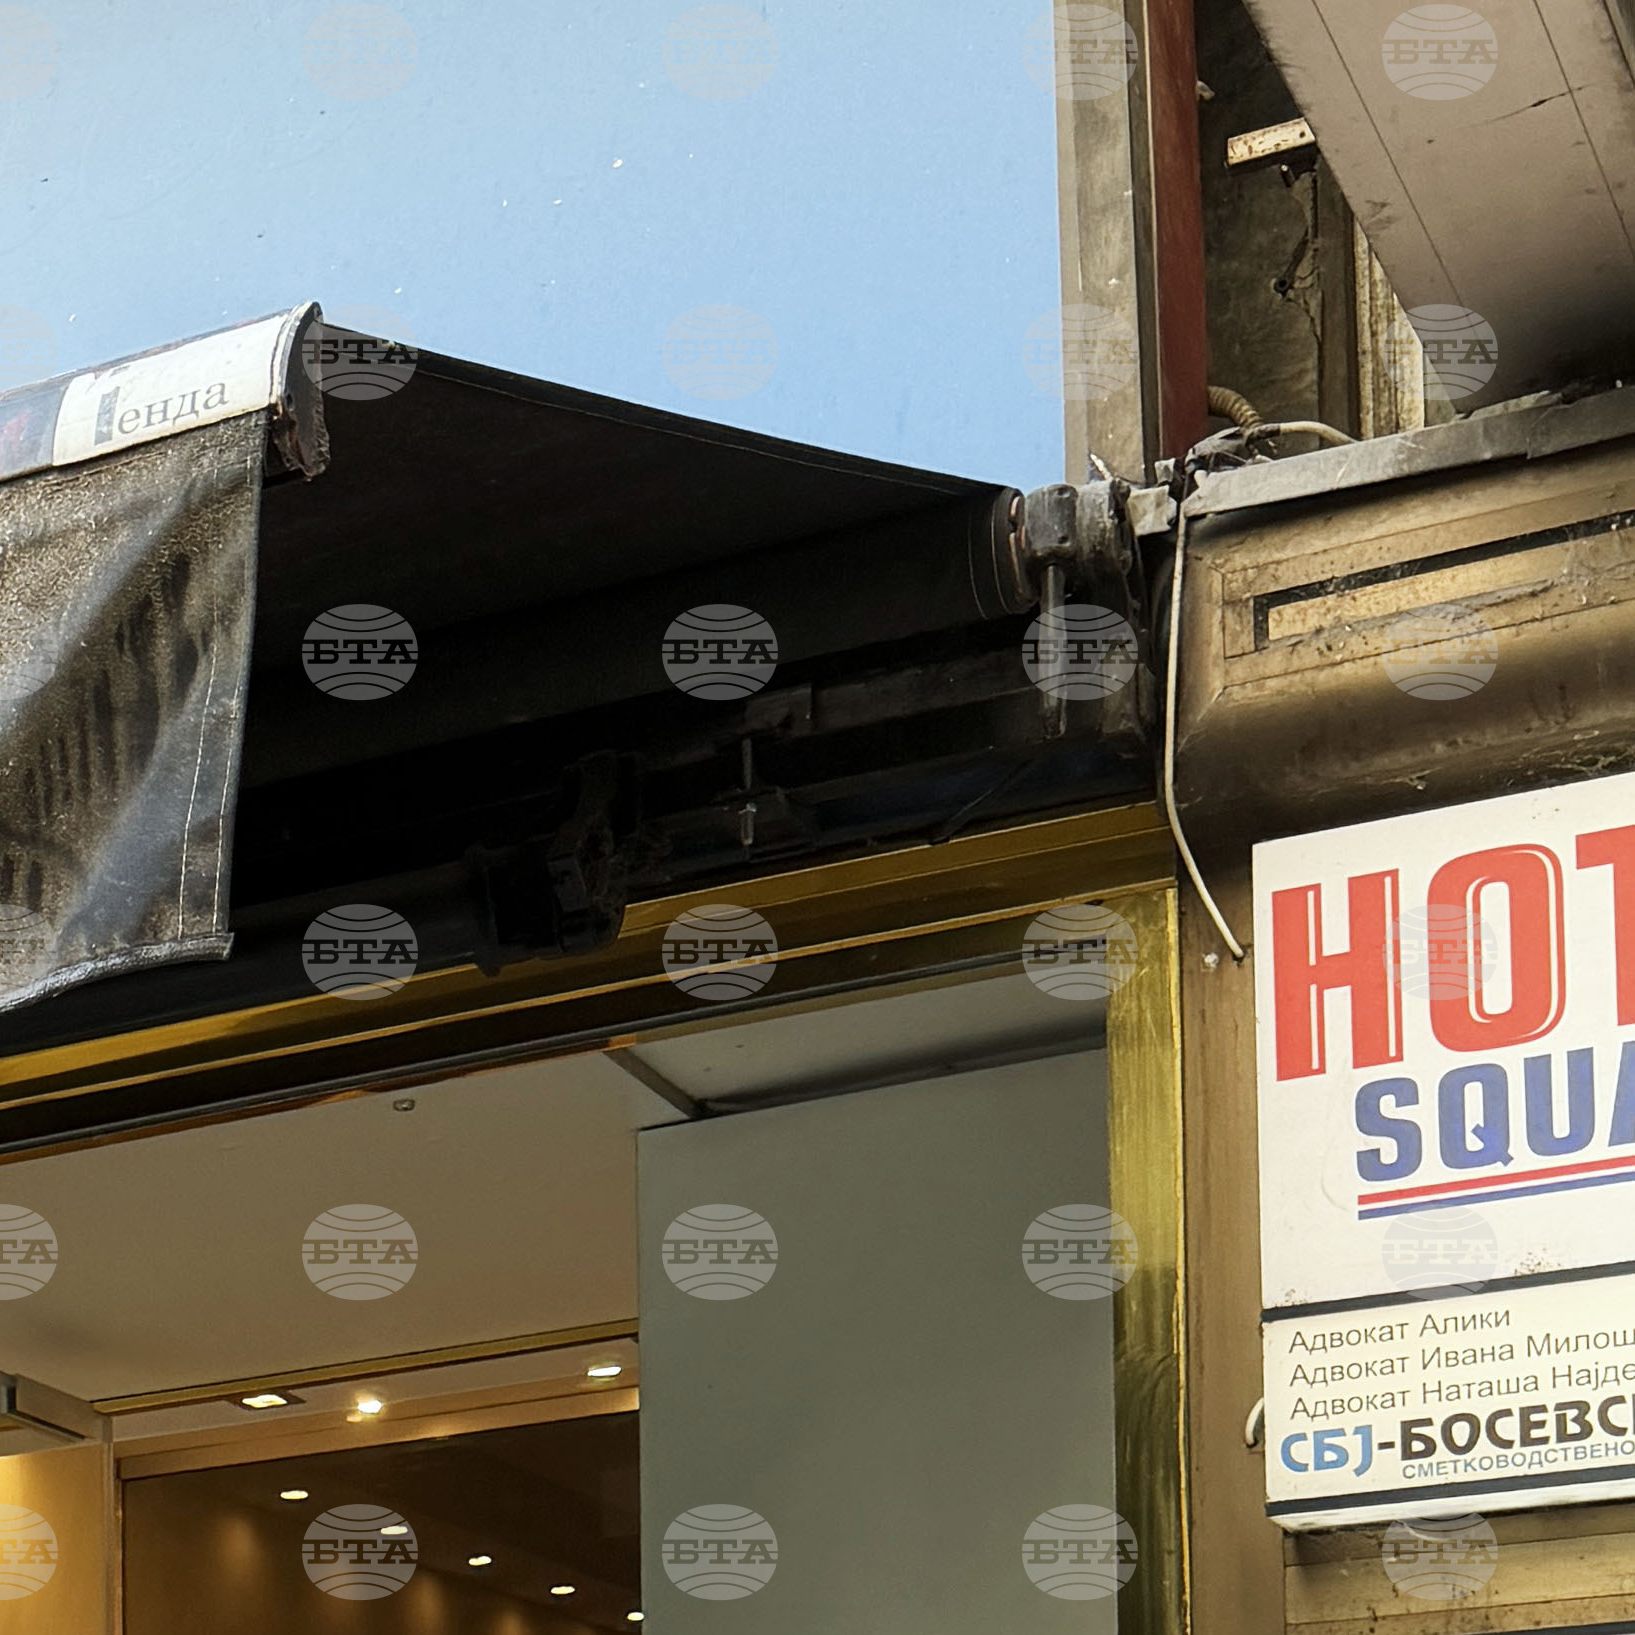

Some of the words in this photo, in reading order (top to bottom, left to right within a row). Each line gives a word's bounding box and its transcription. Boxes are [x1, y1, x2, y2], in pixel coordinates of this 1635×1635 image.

[1288, 1321, 1410, 1354] Адвокат
[1419, 1309, 1511, 1337] Алики
[1290, 1355, 1410, 1388] Адвокат
[1422, 1343, 1514, 1370] Ивана
[1290, 1388, 1411, 1420] Адвокат
[1422, 1373, 1539, 1404] Наташа
[1280, 1393, 1635, 1478] СБЈ-БОСЕВС
